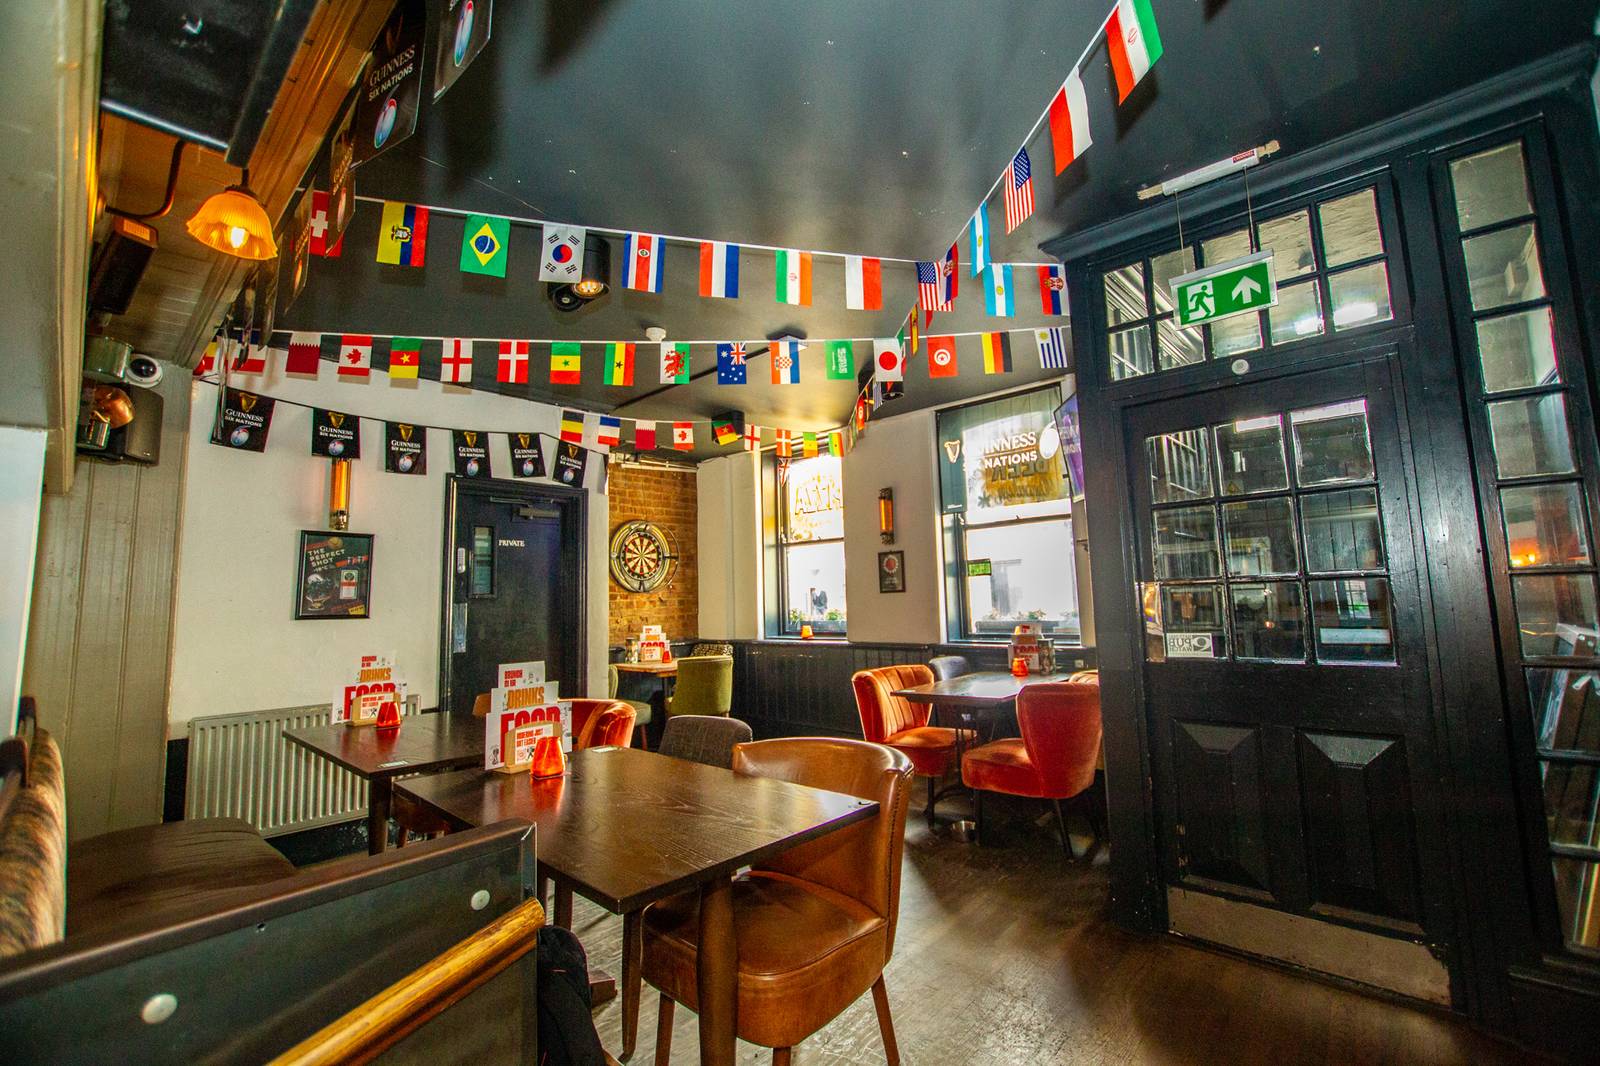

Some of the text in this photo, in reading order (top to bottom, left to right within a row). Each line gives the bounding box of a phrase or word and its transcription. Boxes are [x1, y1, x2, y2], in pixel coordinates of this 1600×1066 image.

[369, 44, 415, 87] GUINNESS
[368, 63, 414, 102] SIX NATIONS
[225, 408, 264, 422] GUINNESS
[235, 418, 263, 428] NATIONS
[319, 425, 354, 436] GUINNESS
[391, 440, 421, 449] GUINNESS
[458, 446, 485, 454] GUINNESS
[984, 451, 1038, 468] NATIONS
[498, 539, 525, 547] PRIVATE
[308, 548, 325, 556] THE
[310, 549, 345, 561] PERFECT
[311, 557, 333, 567] SHOT
[360, 668, 391, 682] DRINKS
[508, 687, 545, 709] DRINKS
